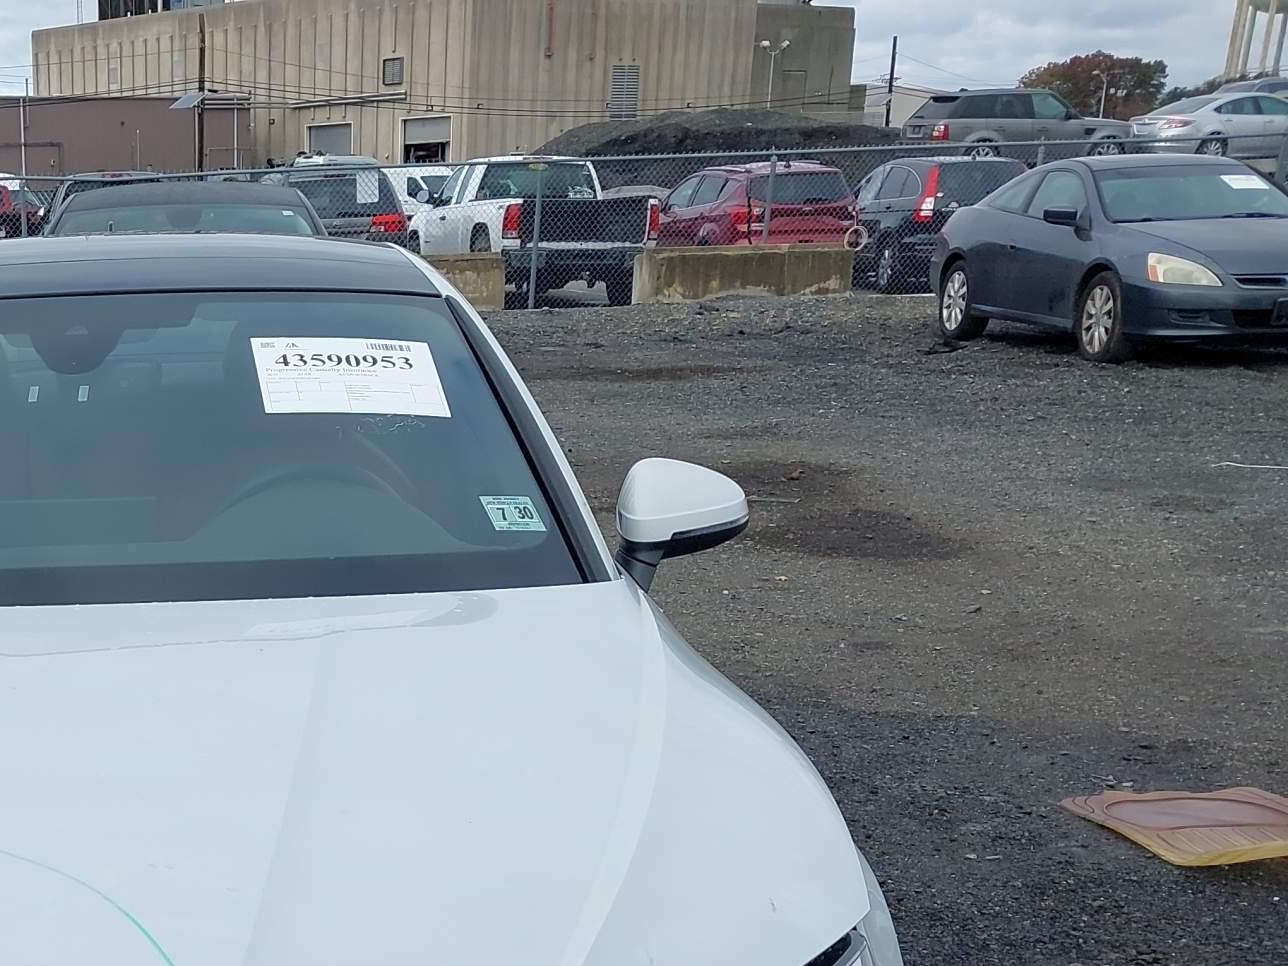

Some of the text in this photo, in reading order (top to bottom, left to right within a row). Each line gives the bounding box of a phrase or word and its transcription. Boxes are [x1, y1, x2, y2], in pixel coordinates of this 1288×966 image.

[274, 353, 414, 370] 43590953
[496, 506, 534, 521] 7 30
